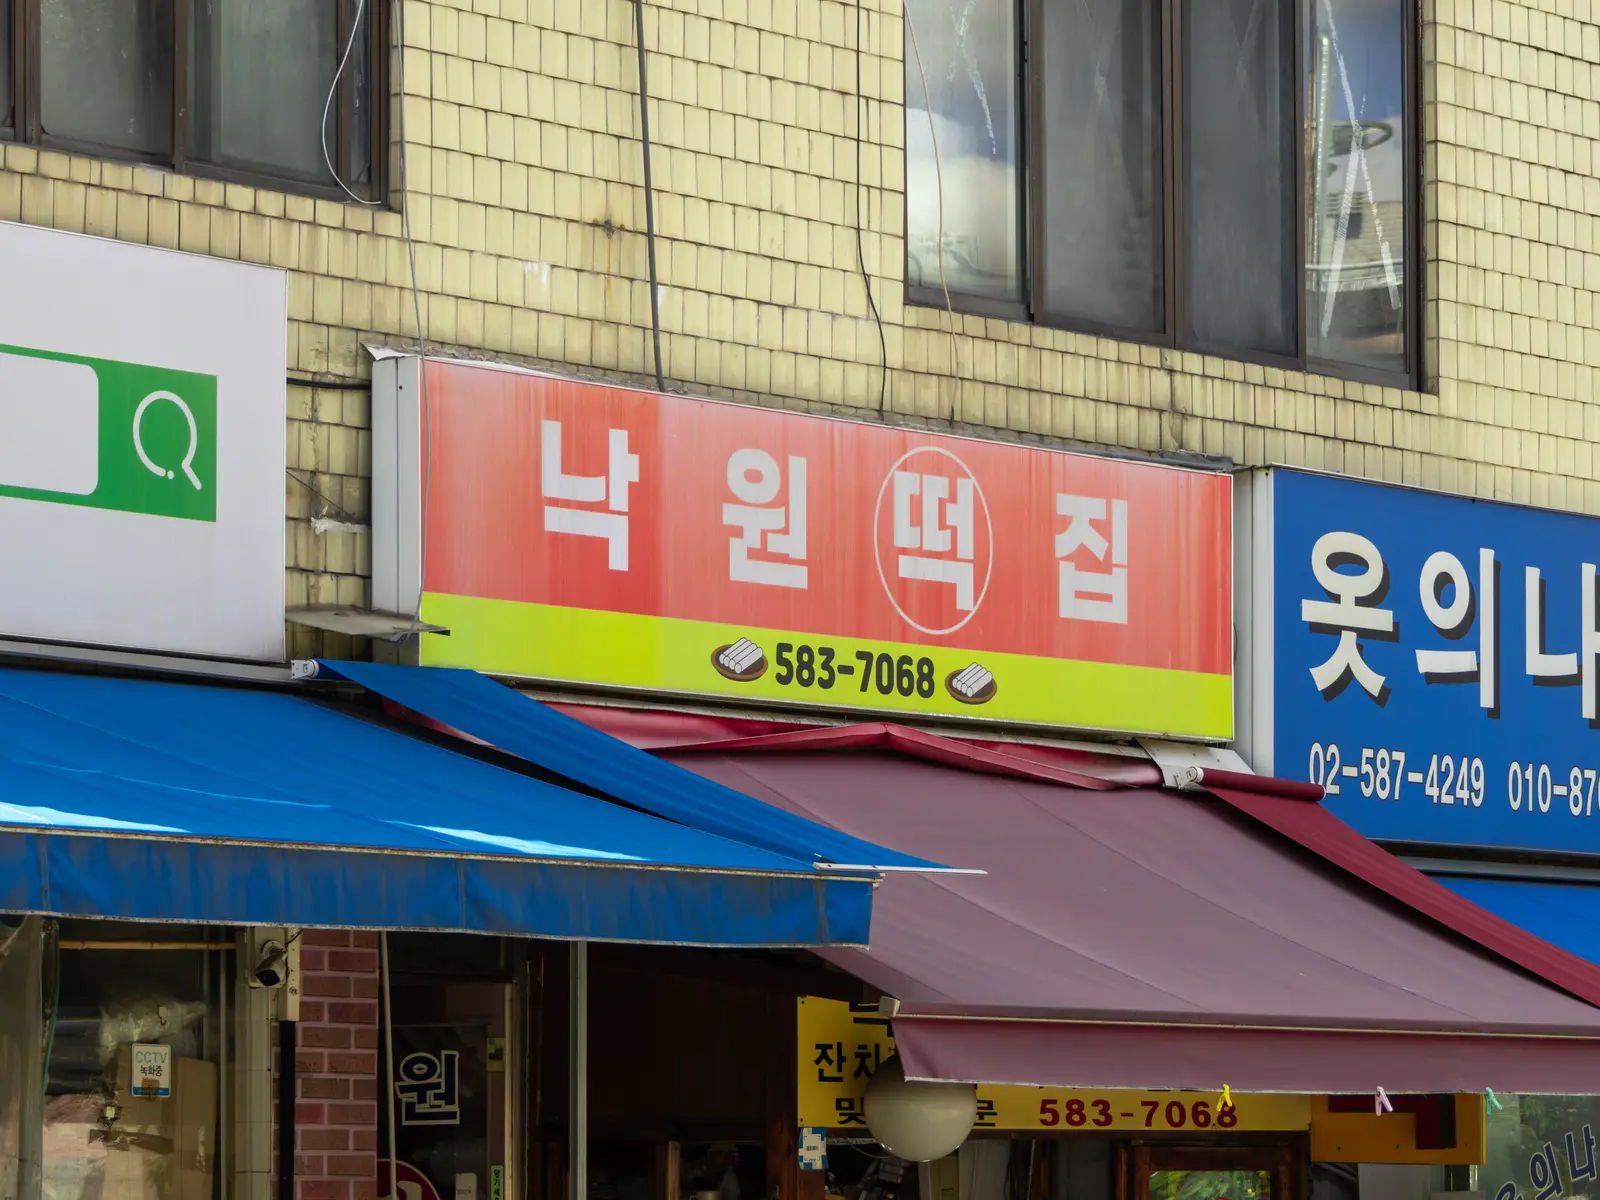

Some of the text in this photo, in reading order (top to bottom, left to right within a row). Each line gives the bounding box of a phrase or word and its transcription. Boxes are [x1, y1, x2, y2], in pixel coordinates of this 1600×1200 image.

[540, 419, 1129, 625] 낙원떡집
[775, 642, 934, 698] 583-7068
[1308, 741, 1600, 818] 02-587-4249 010-87
[135, 1051, 168, 1064] CCTV
[140, 1065, 163, 1077] 녹화중
[395, 1050, 461, 1126] 원
[1039, 1098, 1238, 1128] 583-7068
